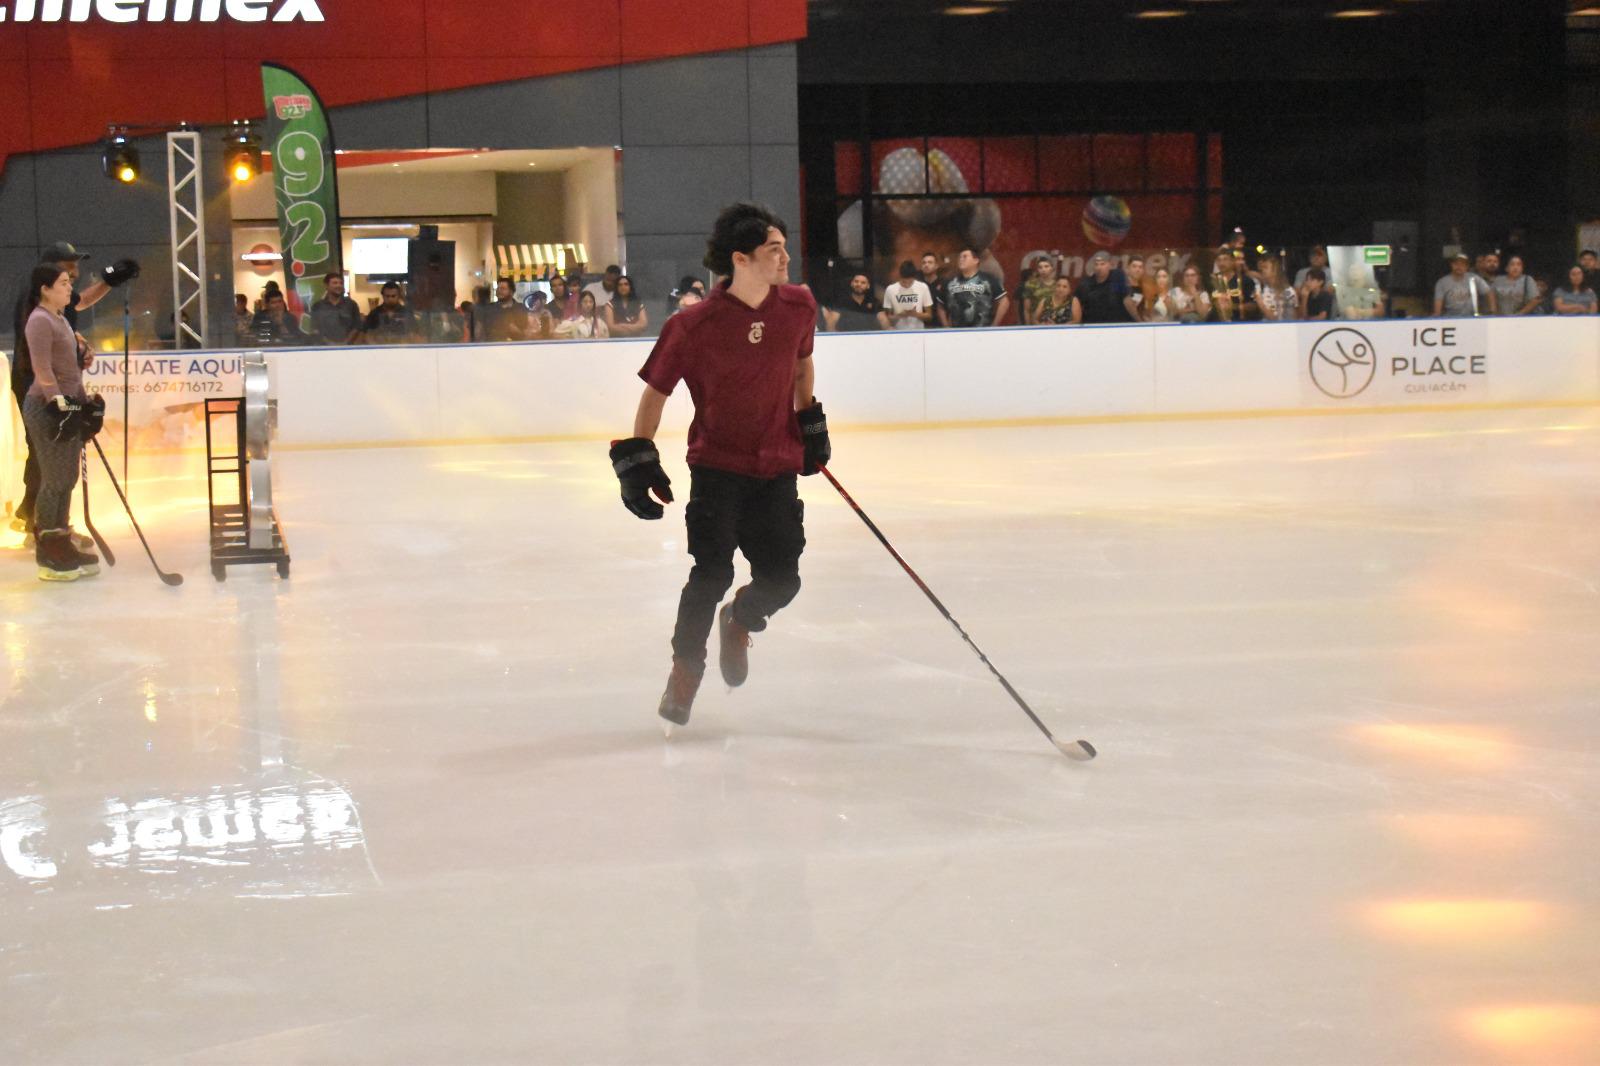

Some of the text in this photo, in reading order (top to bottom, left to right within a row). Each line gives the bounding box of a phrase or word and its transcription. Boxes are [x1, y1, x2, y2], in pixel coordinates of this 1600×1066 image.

[895, 293, 919, 304] VANS
[1413, 327, 1457, 346] ICE
[86, 359, 181, 376] UNCIATE
[1391, 355, 1486, 376] PLACE
[84, 381, 223, 393] formes: 6674716172
